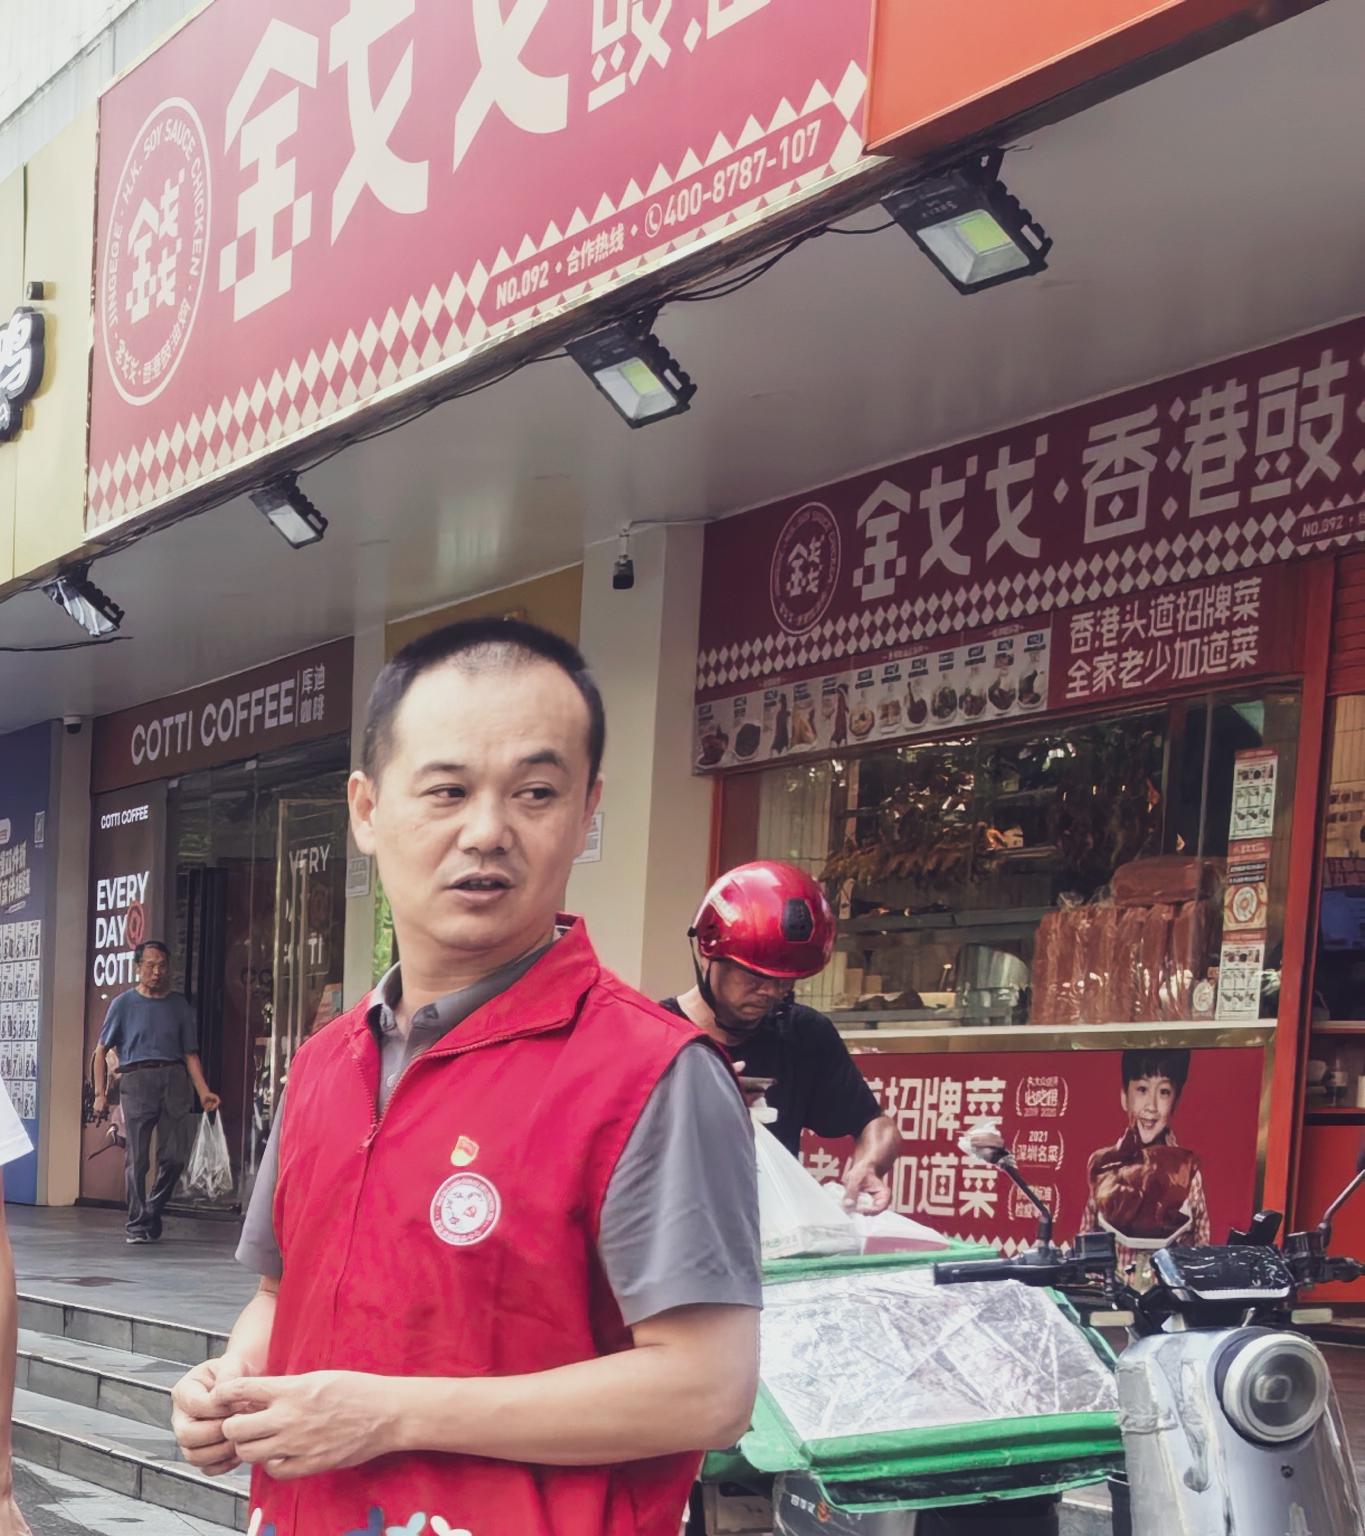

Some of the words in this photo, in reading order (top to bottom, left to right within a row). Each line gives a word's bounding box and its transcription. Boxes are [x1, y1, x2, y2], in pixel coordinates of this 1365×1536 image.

[144, 121, 164, 160] SOY
[164, 118, 196, 161] SAUCE
[188, 153, 207, 277] CHICKEN
[495, 261, 549, 309] NO.092
[566, 223, 625, 276] 合作热线
[663, 120, 822, 226] 400-8787-107
[1070, 577, 1262, 654] 香港头道招牌菜
[1066, 625, 1259, 699] 全家老少加道菜
[131, 714, 194, 766] COTTI
[200, 679, 295, 747] COFFEE
[101, 811, 120, 829] COTTI
[121, 804, 149, 825] COFFEE
[97, 871, 149, 911] EVERY
[93, 951, 141, 987] COTT
[1029, 1131, 1047, 1142] 2021
